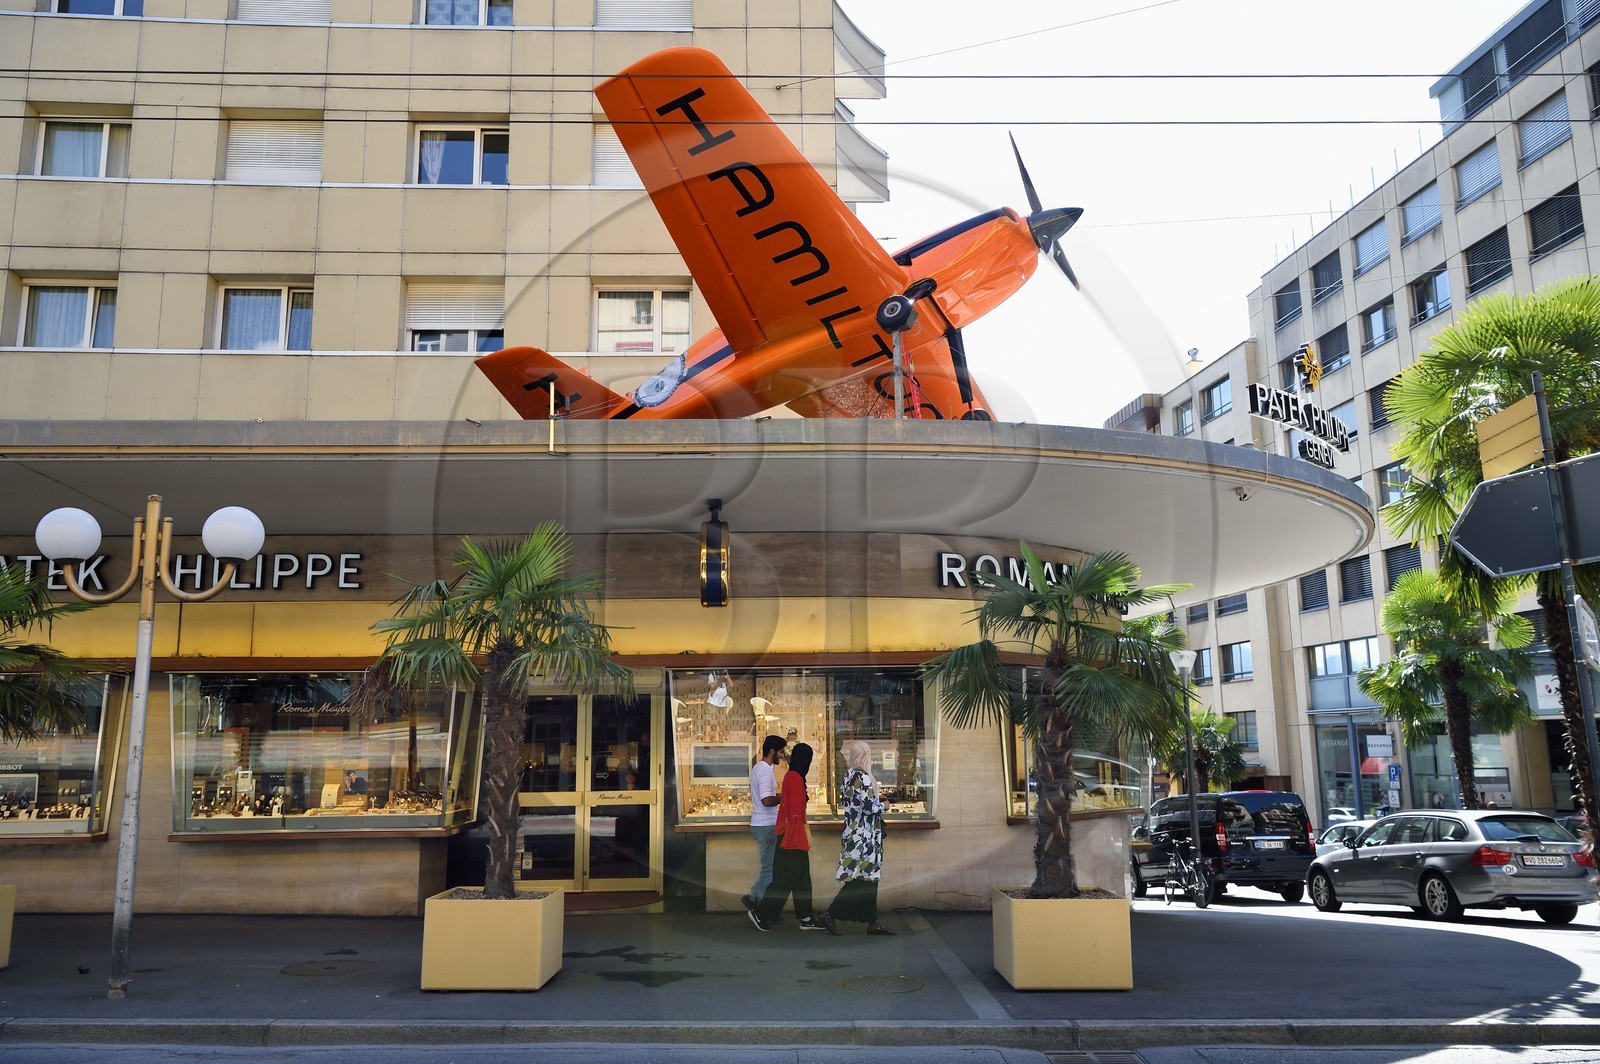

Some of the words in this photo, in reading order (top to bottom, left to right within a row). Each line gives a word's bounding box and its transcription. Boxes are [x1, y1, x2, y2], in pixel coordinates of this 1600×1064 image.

[1250, 383, 1310, 429] PATEK
[1307, 403, 1350, 451] PHILIPP
[157, 553, 361, 589] HILIPPE
[940, 553, 1077, 591] ROMA
[277, 703, 315, 713] Roman
[1505, 865, 1515, 874] CH
